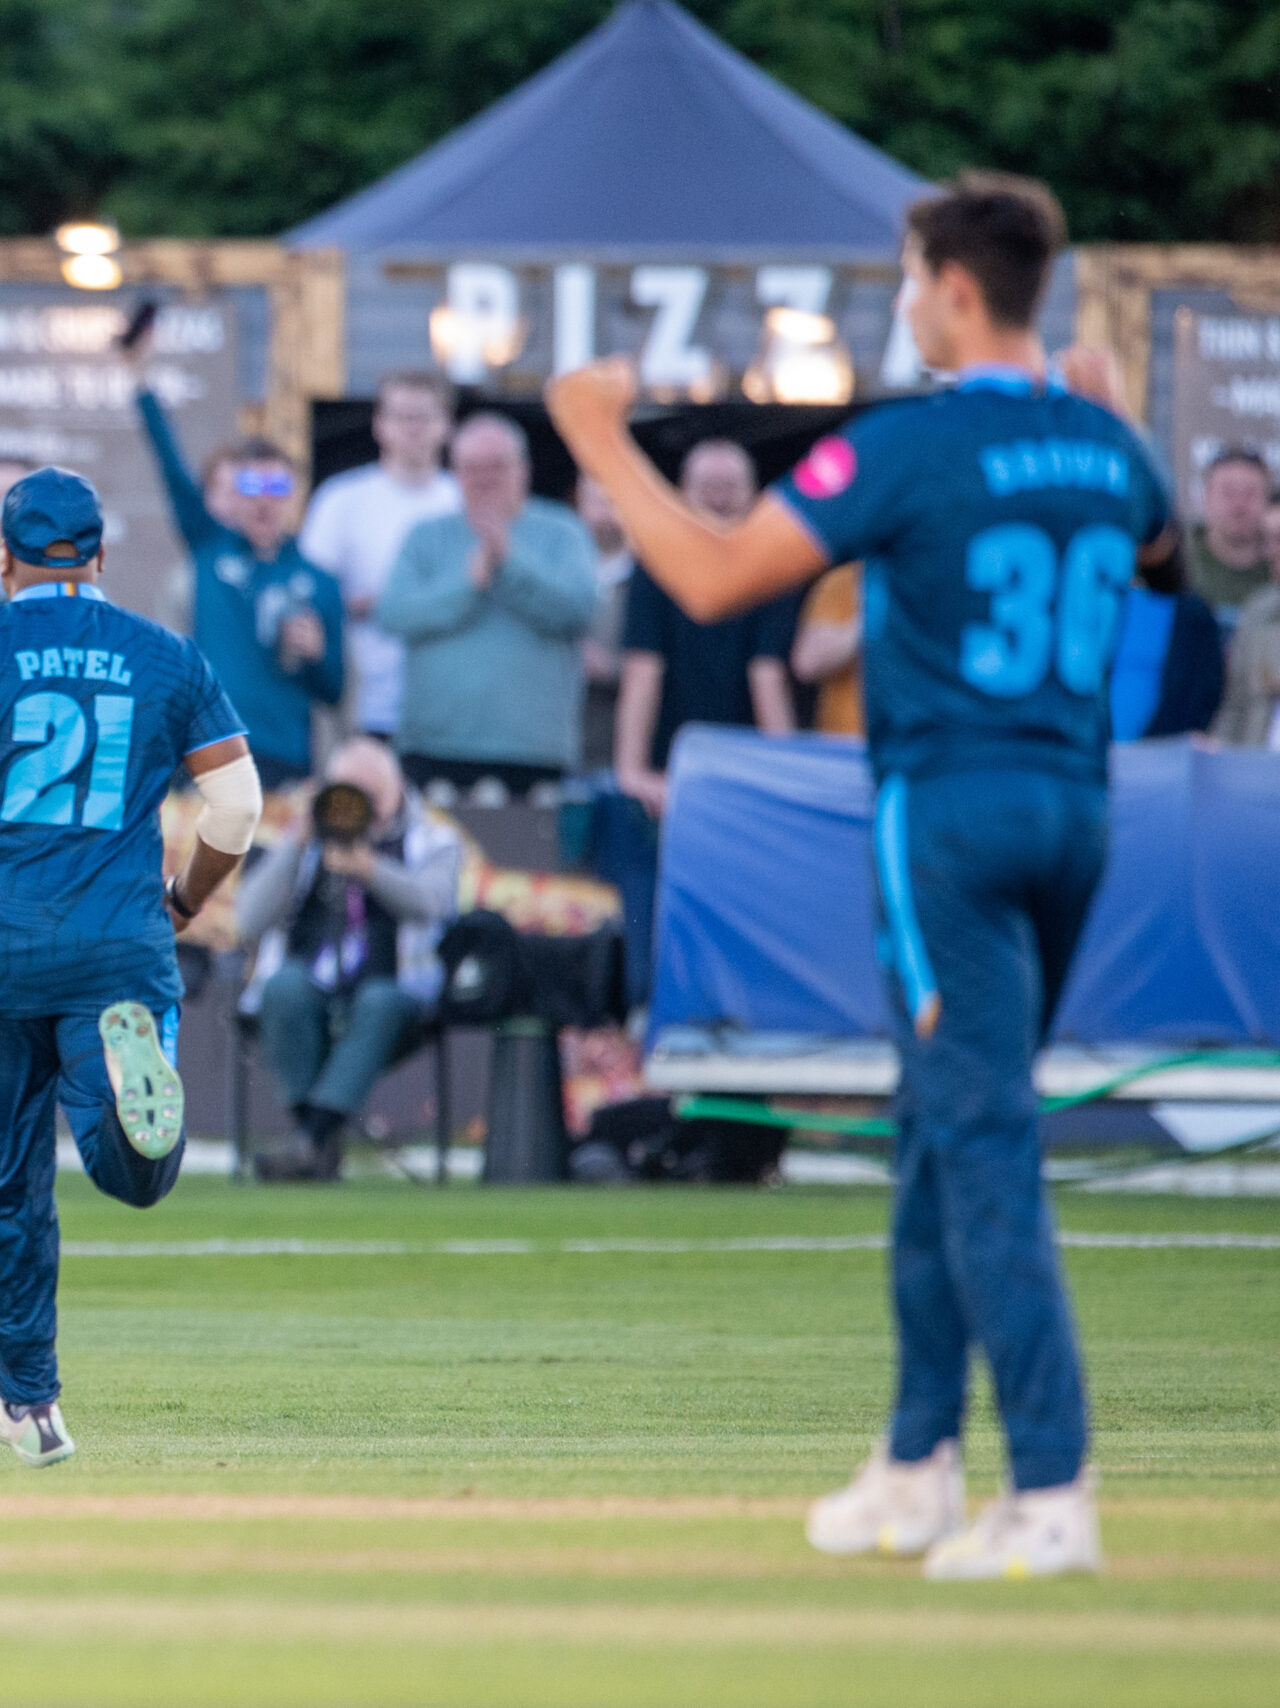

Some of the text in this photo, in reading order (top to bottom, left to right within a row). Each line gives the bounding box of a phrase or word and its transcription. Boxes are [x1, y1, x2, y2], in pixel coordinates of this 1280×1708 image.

[15, 646, 133, 687] PATEL
[960, 523, 1137, 697] 36
[0, 691, 134, 831] 21
